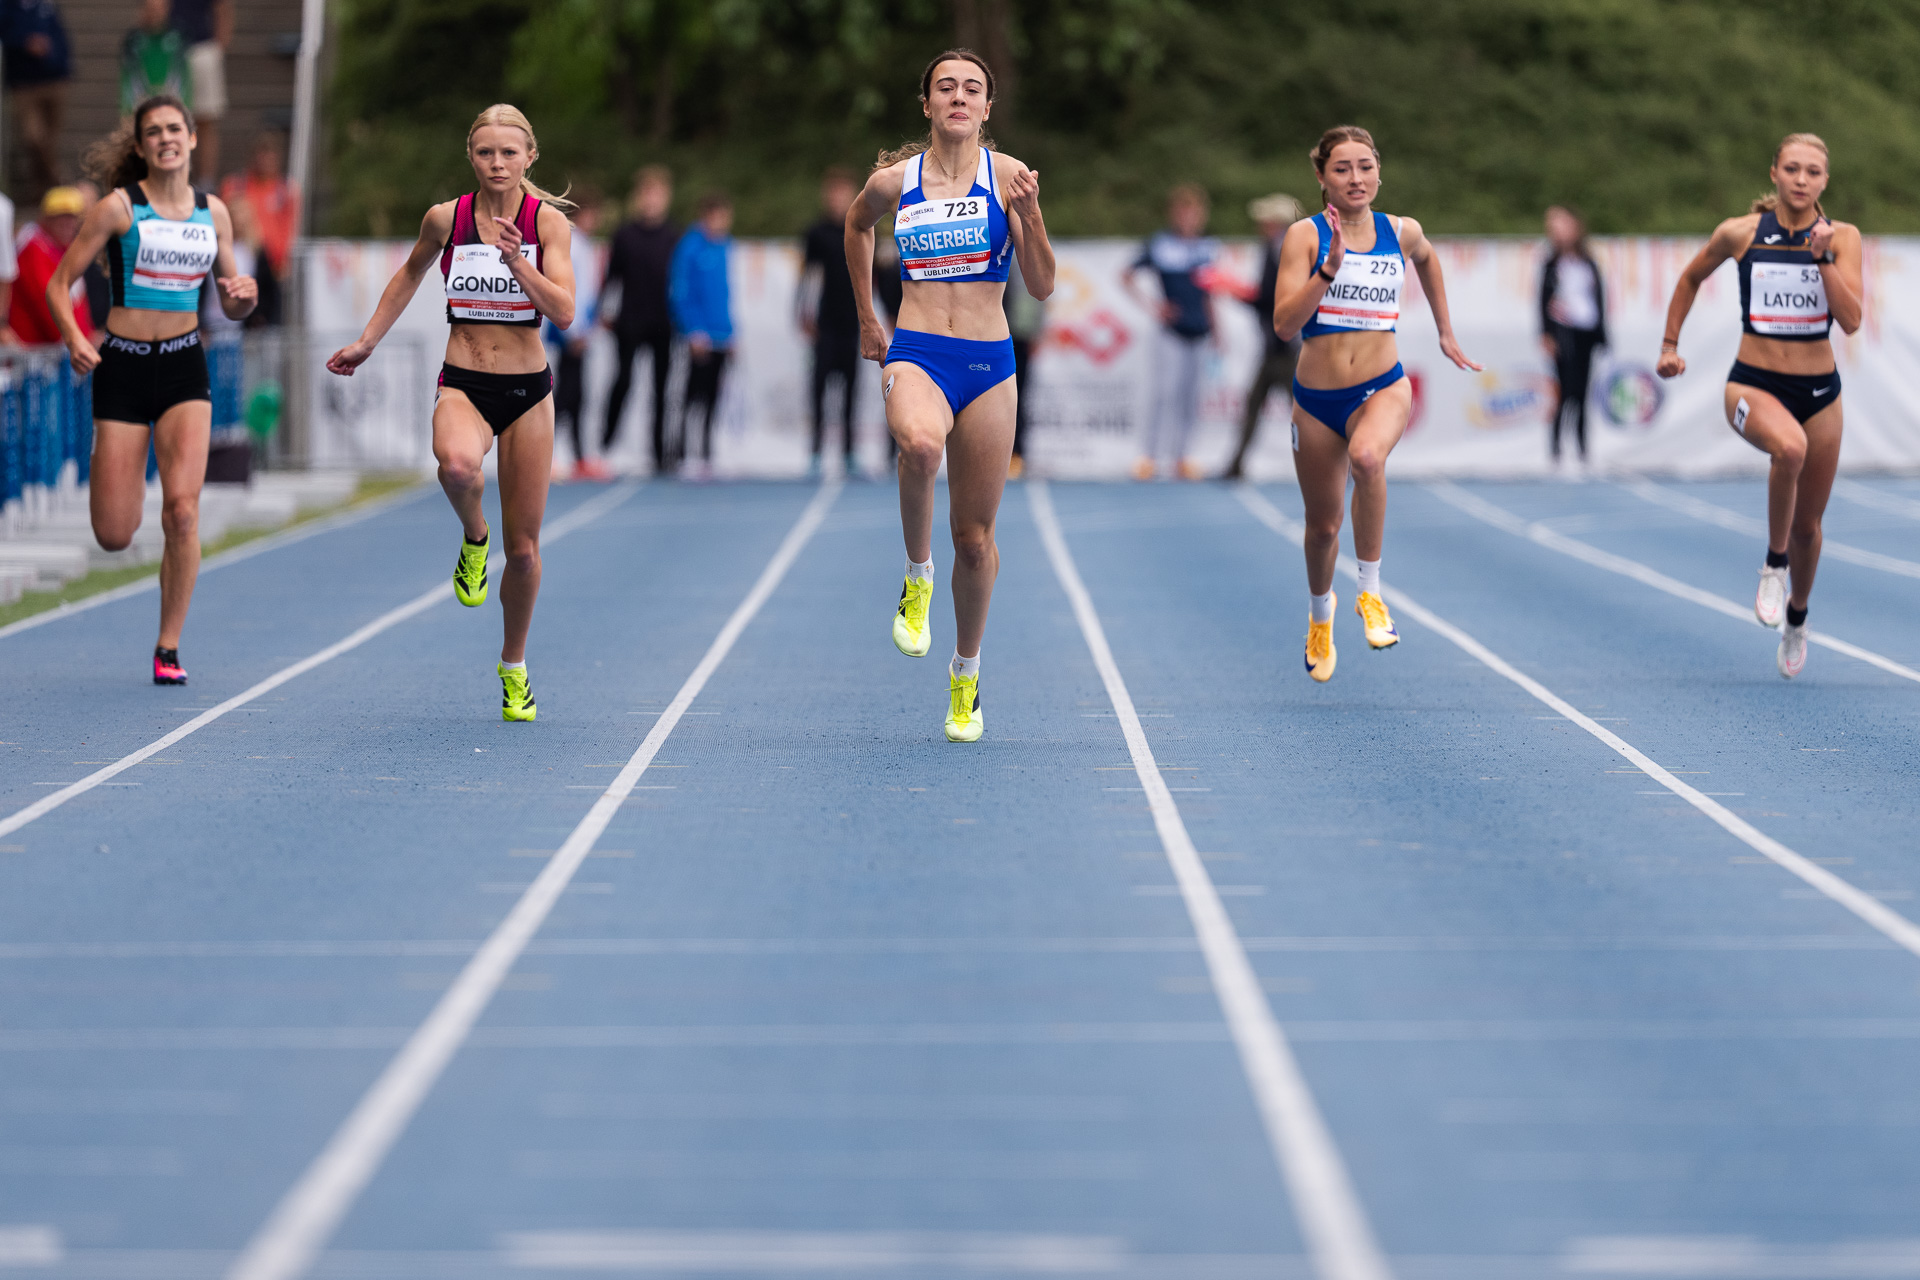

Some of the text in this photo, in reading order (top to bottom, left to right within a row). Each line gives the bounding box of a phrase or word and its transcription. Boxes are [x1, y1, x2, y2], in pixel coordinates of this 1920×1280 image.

[911, 207, 934, 216] LUBELSKIE
[944, 201, 979, 218] 723
[182, 227, 208, 241] 601
[898, 226, 988, 253] PASIERBEK
[140, 248, 212, 267] ULIKOWSKA
[923, 265, 971, 277] LUBLIN 2026
[1370, 261, 1397, 276] 275
[452, 276, 525, 294] GONDE
[1325, 284, 1396, 303] NIEZGODA
[1764, 290, 1818, 308] LATOŃ
[468, 310, 515, 319] LUBLIN 2026
[109, 337, 152, 355] PRO
[159, 331, 198, 354] NIKE
[968, 363, 991, 372] esa
